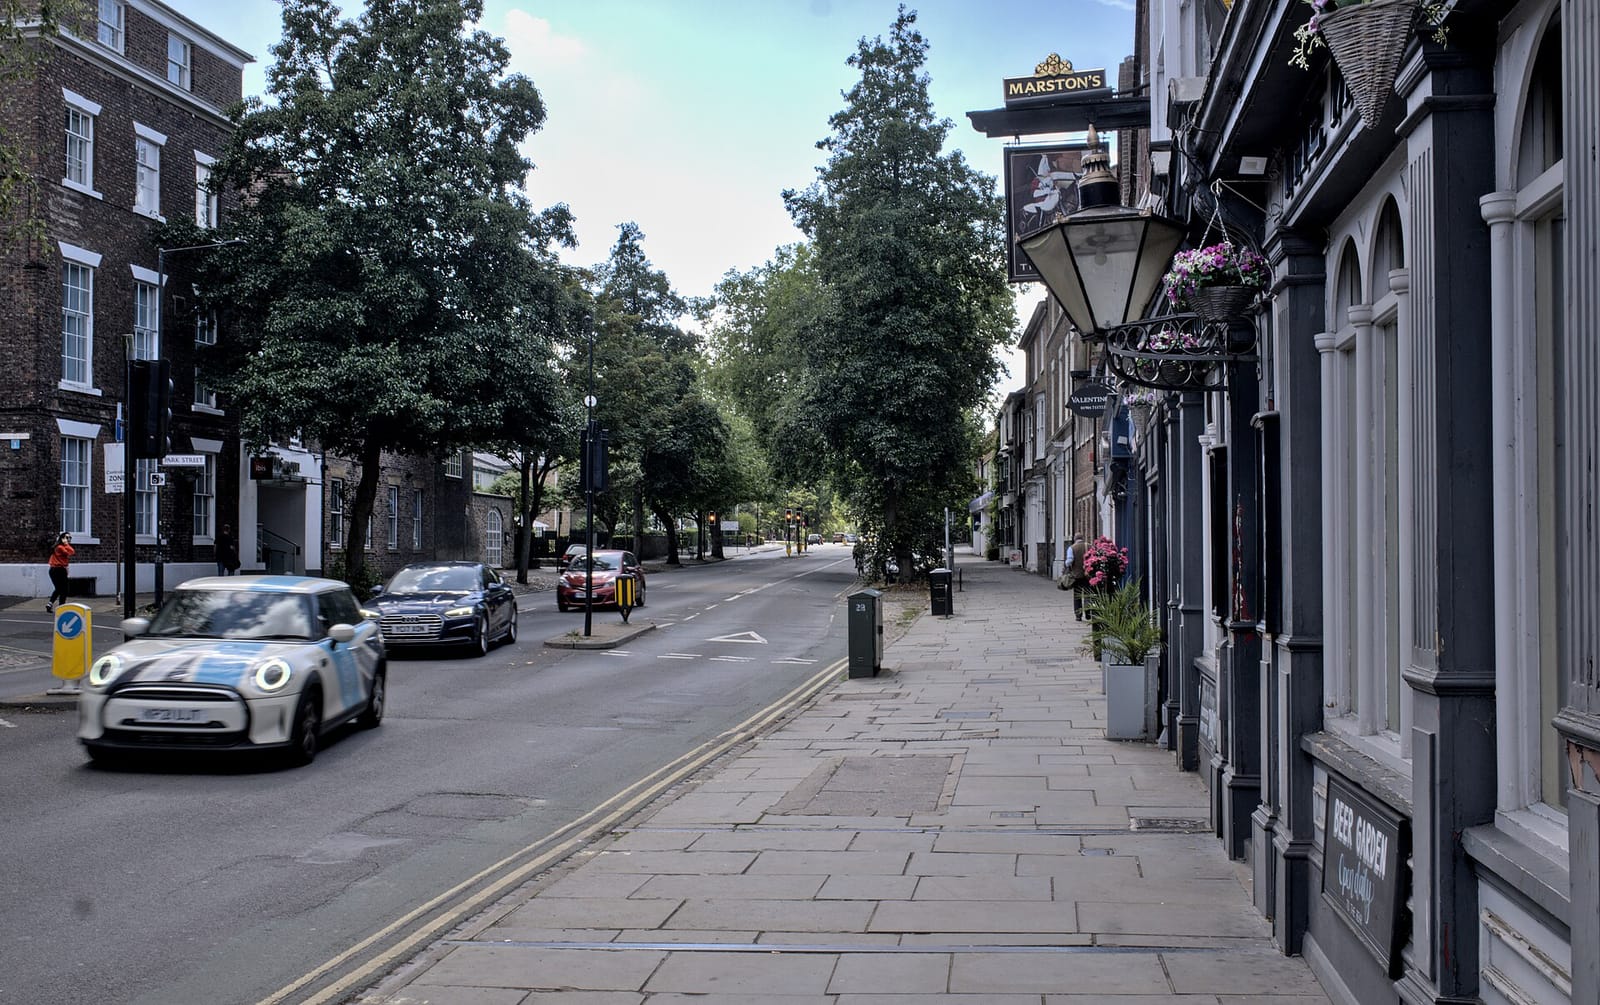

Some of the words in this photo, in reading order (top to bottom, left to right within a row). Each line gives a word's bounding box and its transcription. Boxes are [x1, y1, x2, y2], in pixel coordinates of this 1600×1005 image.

[1009, 75, 1101, 94] MARSTON'S
[1333, 798, 1353, 850] BEER
[1356, 815, 1388, 880] GARDEN
